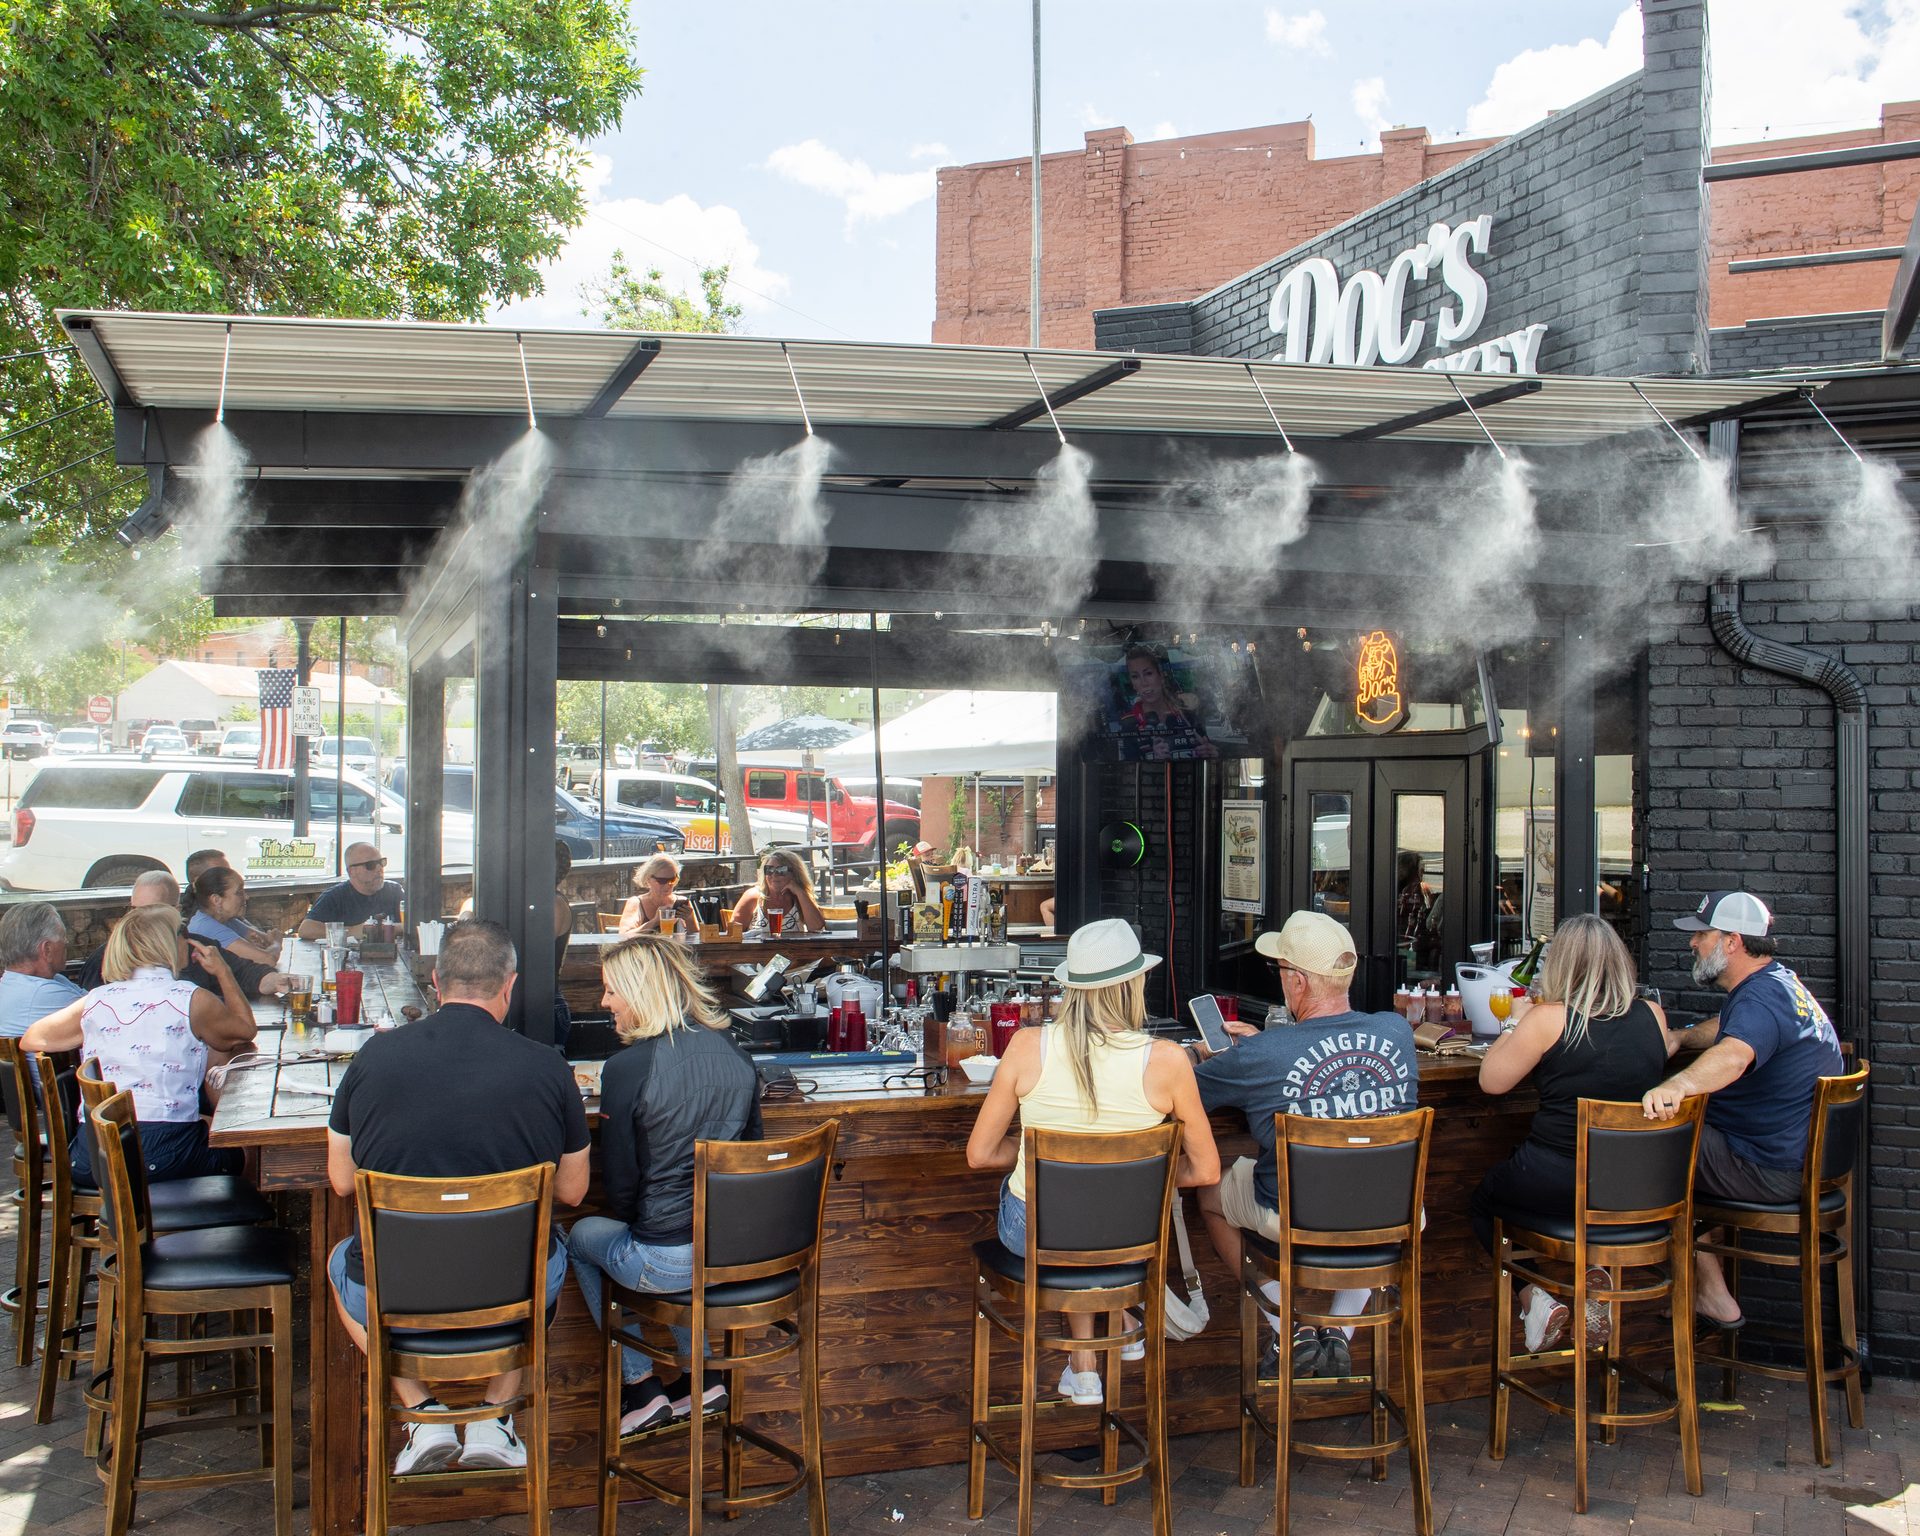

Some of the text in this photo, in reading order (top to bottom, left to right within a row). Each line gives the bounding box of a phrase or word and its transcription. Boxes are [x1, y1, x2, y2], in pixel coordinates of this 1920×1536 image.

[302, 689, 311, 697] NO
[297, 697, 316, 706] BIKING
[295, 714, 318, 722] SKATING
[294, 722, 318, 730] ALLOWED
[247, 857, 326, 868] MERCANTILE
[971, 882, 979, 904] ULTRA
[997, 1019, 1016, 1027] Coca-Cola
[1283, 1032, 1409, 1099] SPRINGFIELD
[1308, 1056, 1393, 1096] 250 YEARS OF FREEDOM
[1286, 1081, 1409, 1119] ARMORY
